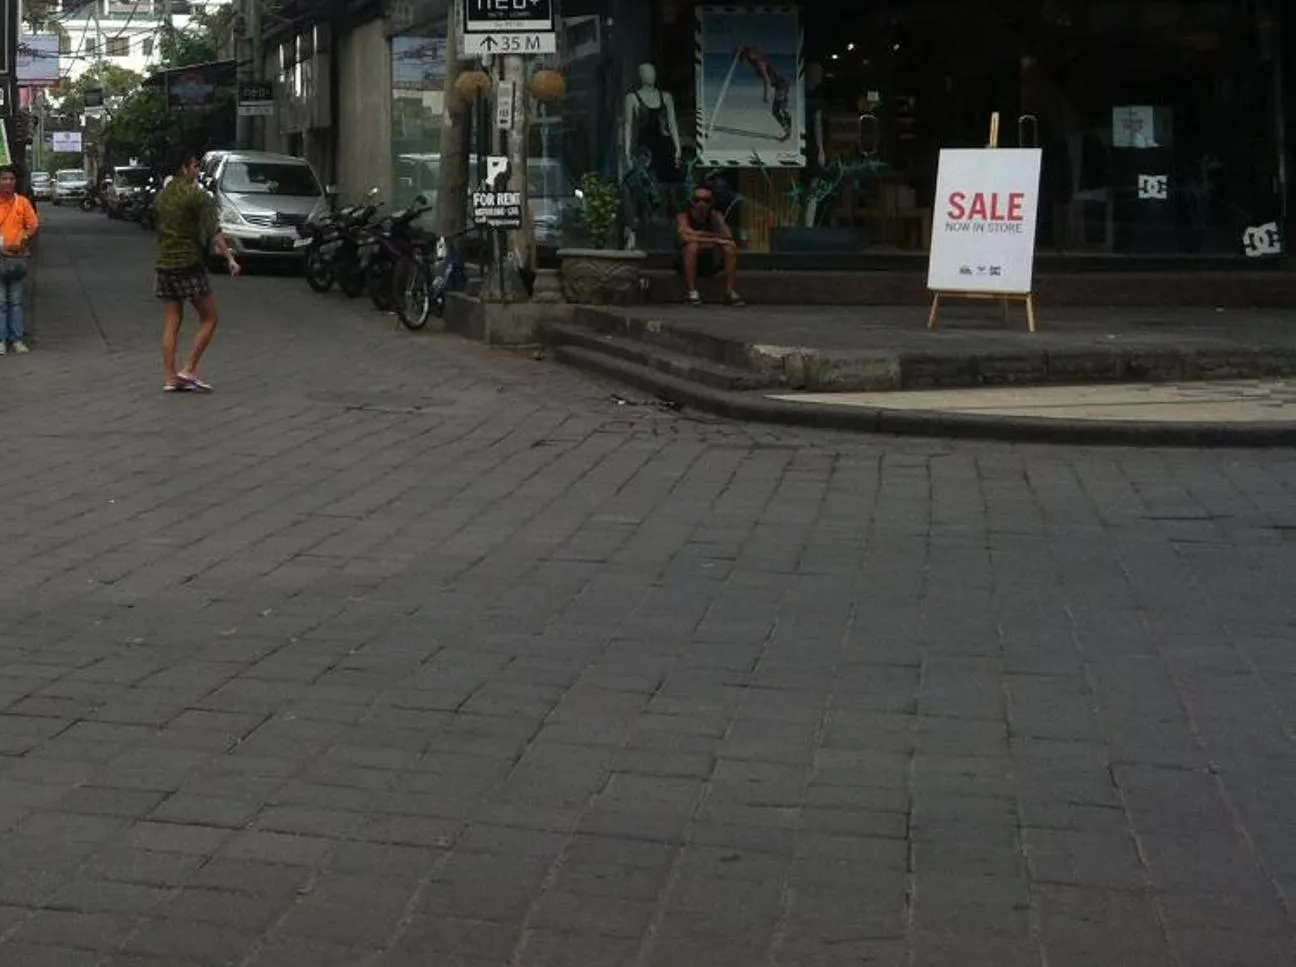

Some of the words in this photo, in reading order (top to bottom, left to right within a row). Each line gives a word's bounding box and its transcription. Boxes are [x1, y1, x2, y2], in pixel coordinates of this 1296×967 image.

[501, 35, 521, 51] 35
[524, 35, 541, 50] M
[473, 192, 495, 206] FOR
[497, 192, 521, 206] RENT
[947, 191, 1025, 222] SALE
[945, 221, 970, 233] NOW
[972, 222, 984, 234] IN
[987, 222, 1023, 235] STORE
